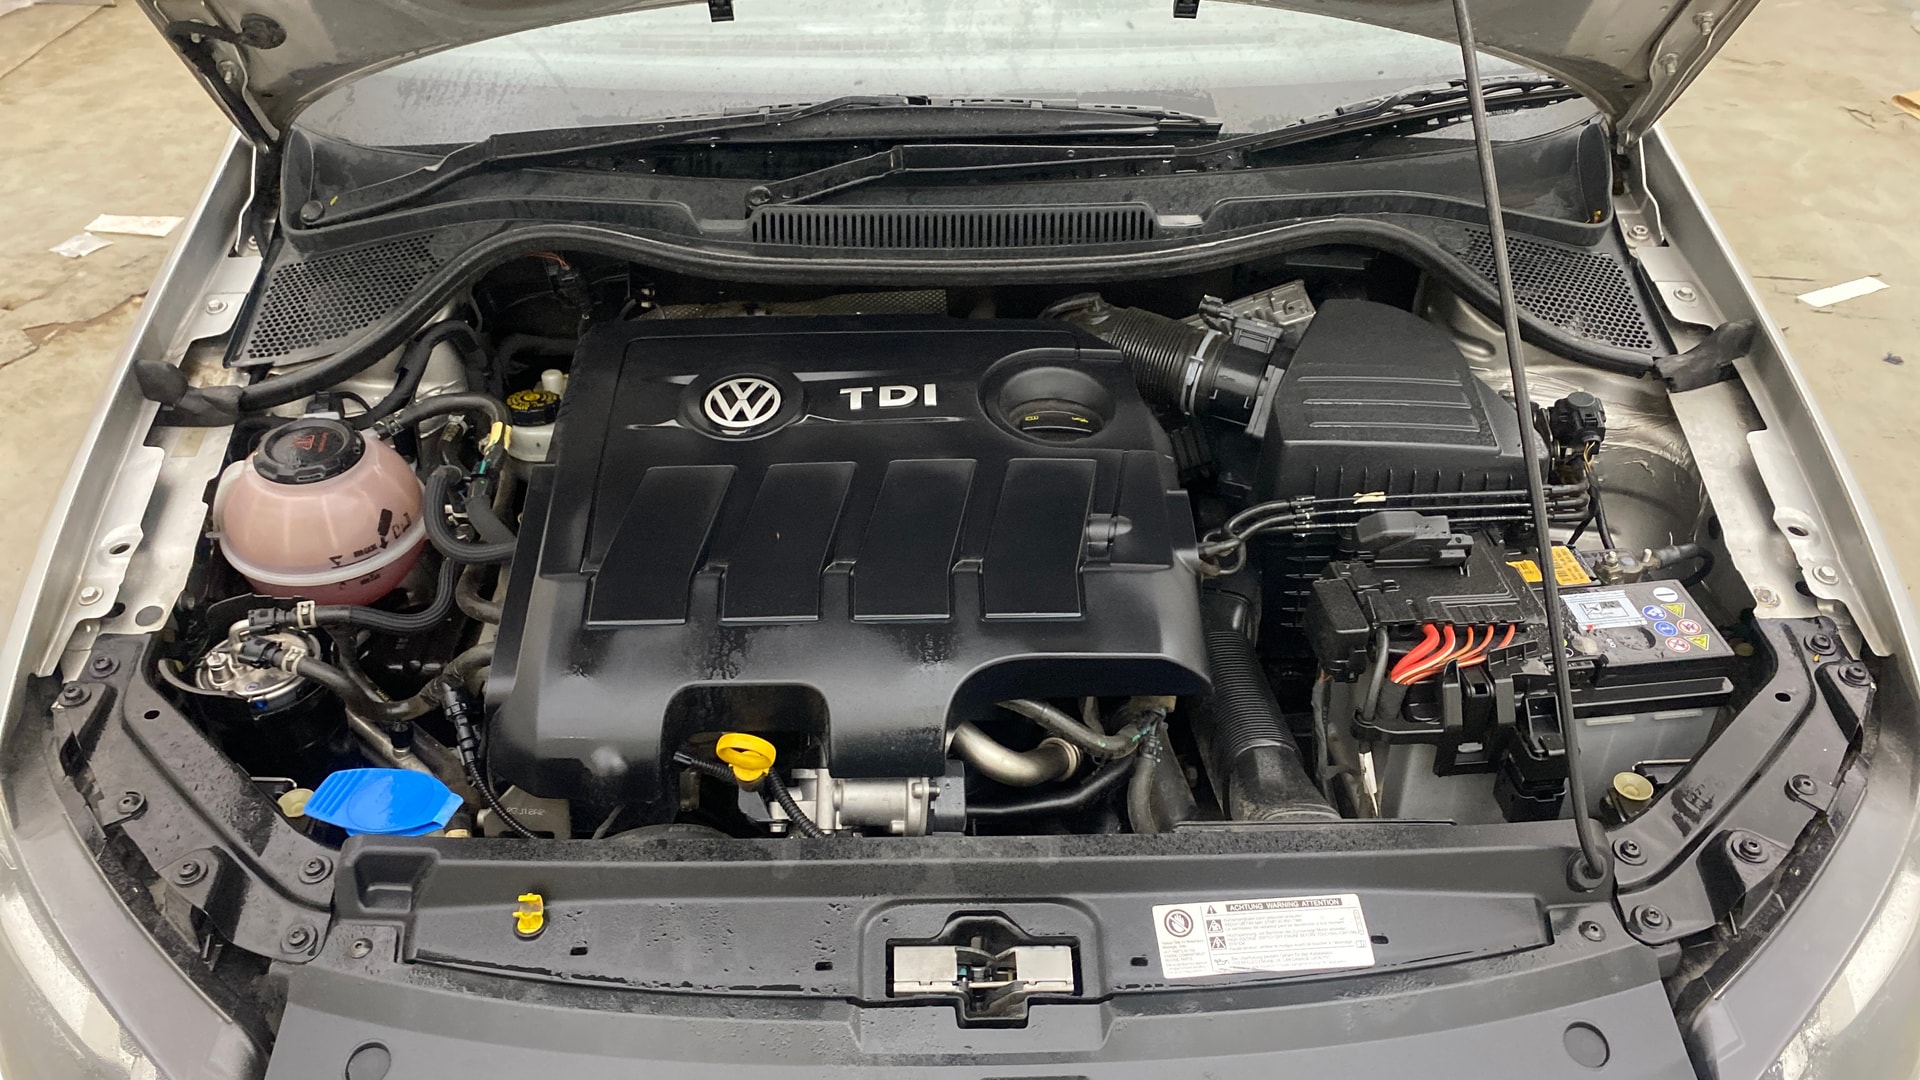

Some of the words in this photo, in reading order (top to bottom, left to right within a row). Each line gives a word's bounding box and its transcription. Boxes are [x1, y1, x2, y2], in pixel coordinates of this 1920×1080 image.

[705, 378, 782, 428] VW
[839, 383, 937, 410] TDI
[1229, 902, 1263, 912] ACHTUNG
[1266, 900, 1299, 910] WARNING
[1301, 898, 1340, 908] ATTENTION
